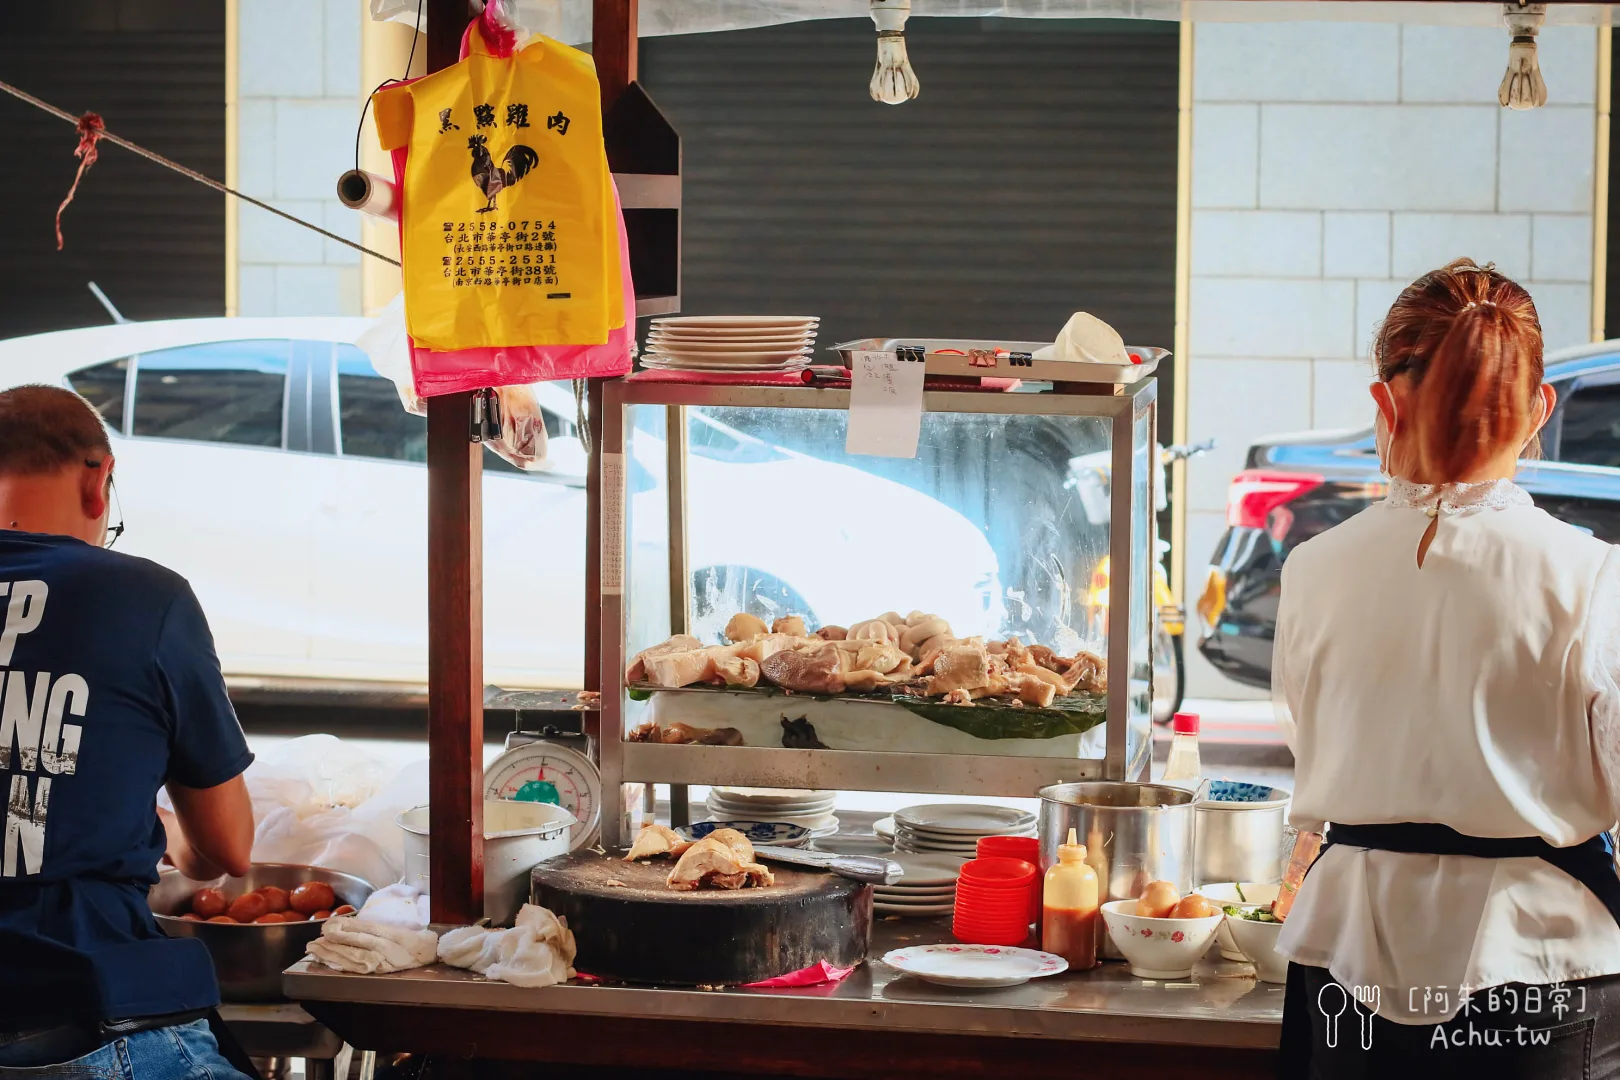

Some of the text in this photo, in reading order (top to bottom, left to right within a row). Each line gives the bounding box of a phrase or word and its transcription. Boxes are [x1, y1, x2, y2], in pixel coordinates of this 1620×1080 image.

[457, 220, 556, 232] 2558-0754
[444, 231, 556, 244] 台北市華亭街2號
[455, 254, 556, 265] 2555-2531
[443, 265, 557, 278] 台北市華亭街38號
